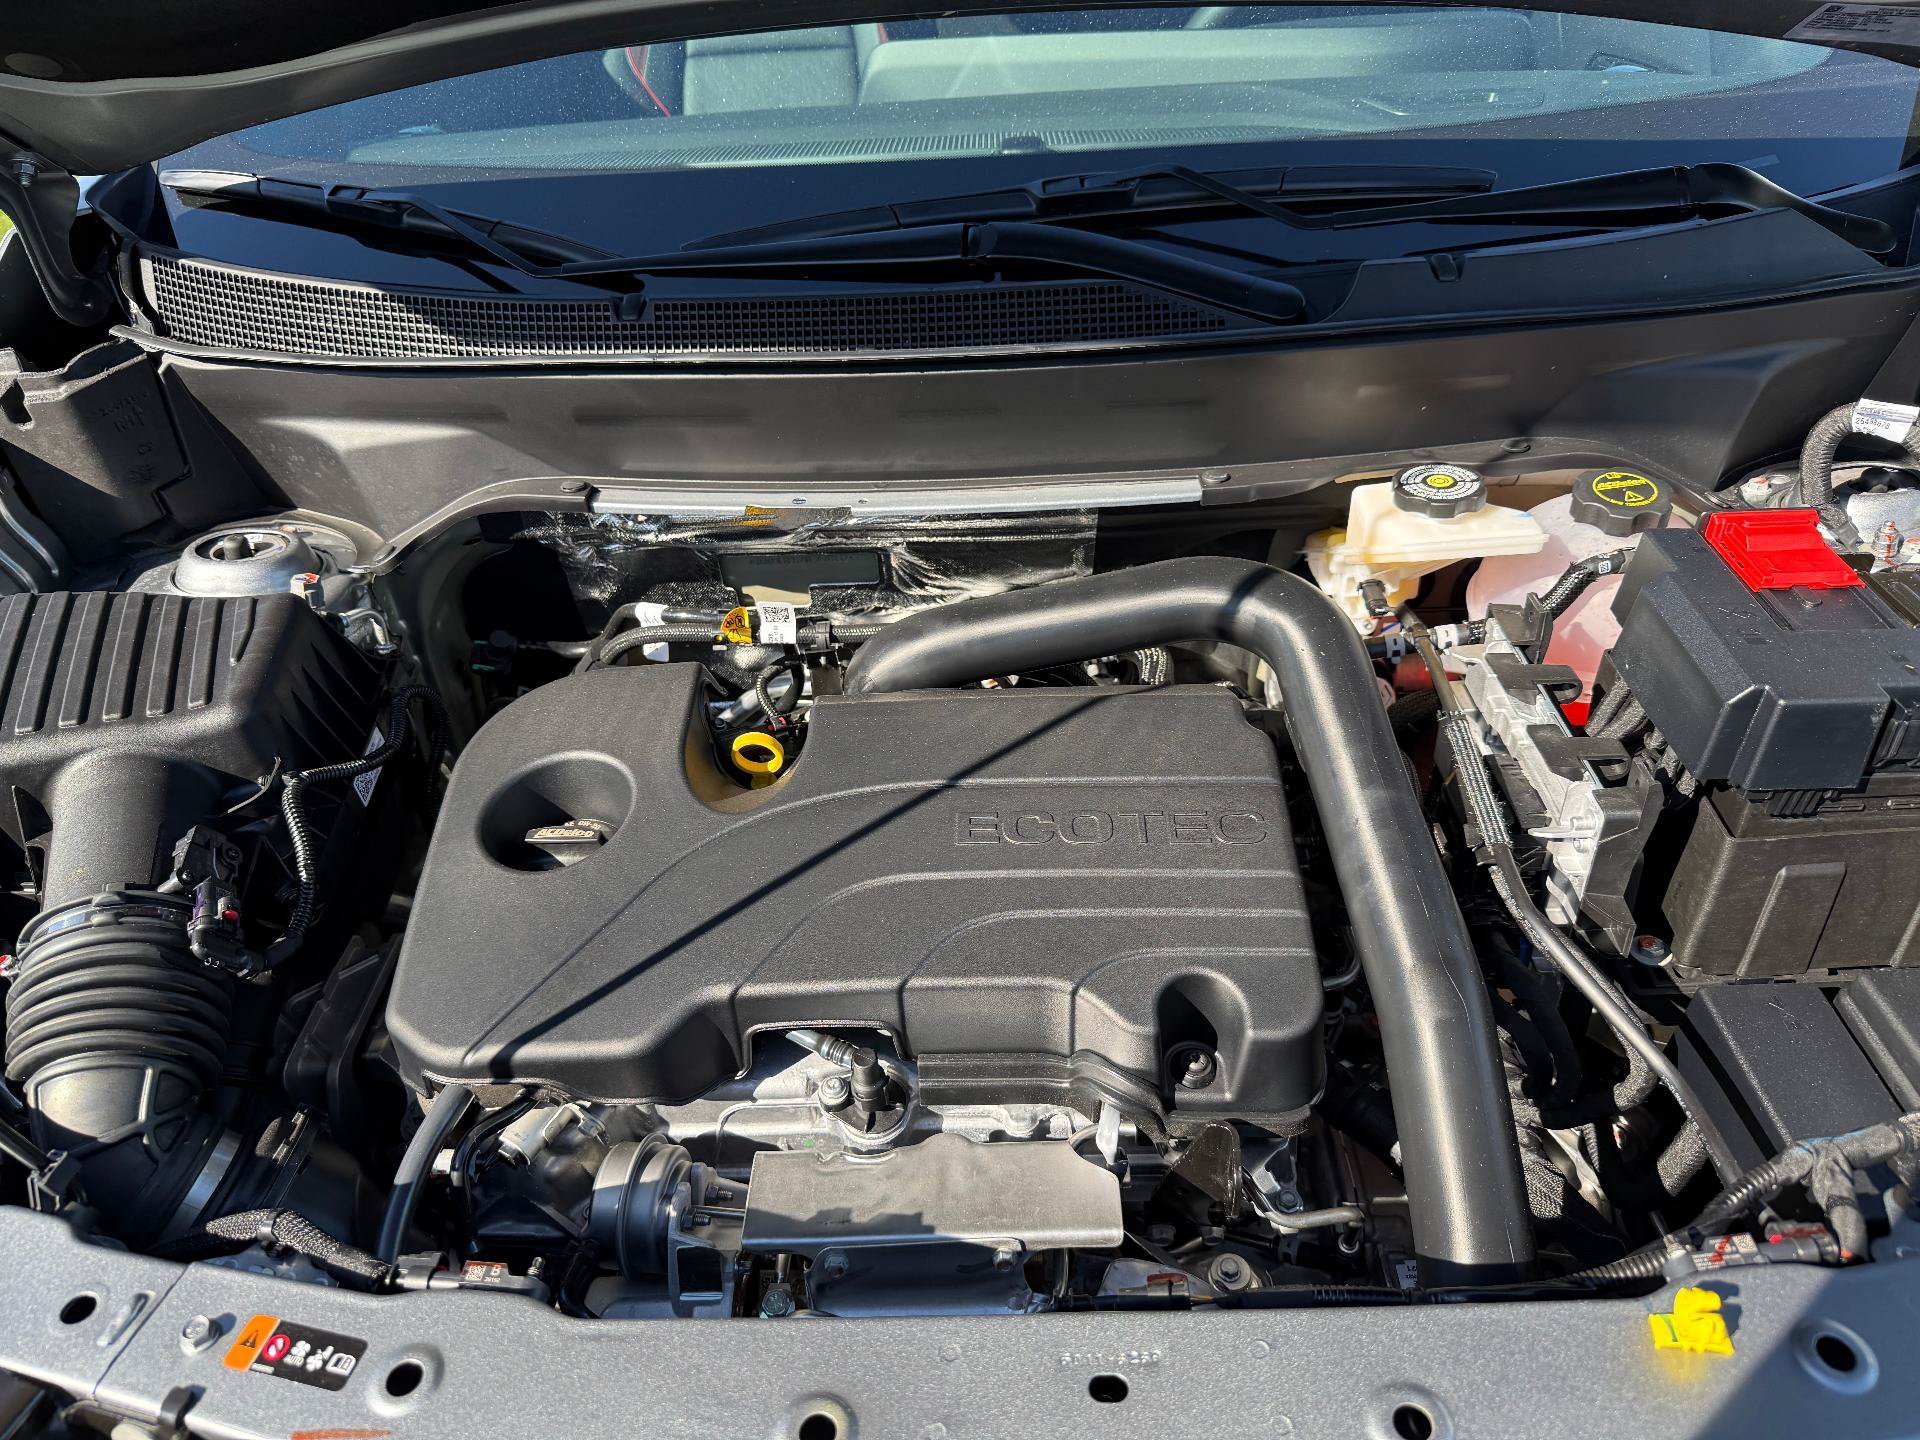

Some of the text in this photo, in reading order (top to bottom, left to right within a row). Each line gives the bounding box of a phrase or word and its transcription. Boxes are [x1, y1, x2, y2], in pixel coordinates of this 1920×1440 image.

[533, 828, 595, 838] ACDelco
[955, 810, 1267, 845] ECOTEC
[283, 1354, 305, 1368] AUTO
